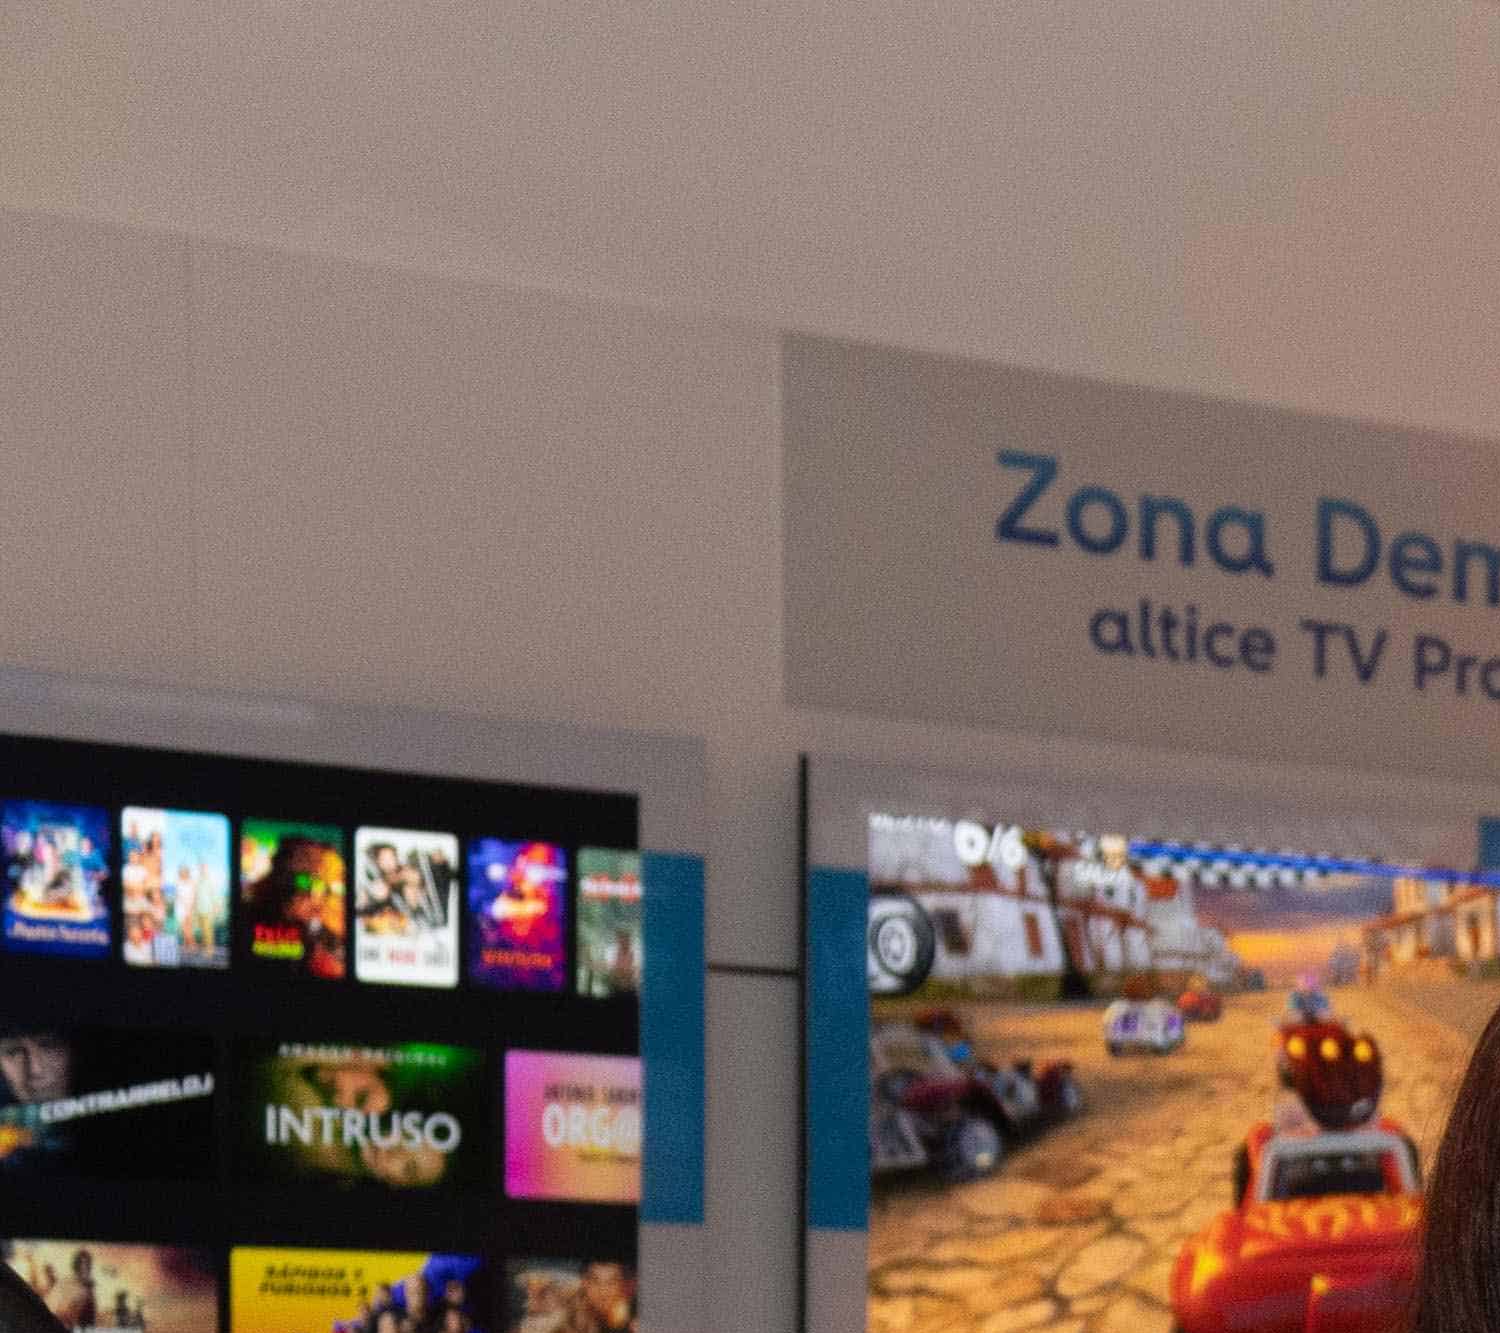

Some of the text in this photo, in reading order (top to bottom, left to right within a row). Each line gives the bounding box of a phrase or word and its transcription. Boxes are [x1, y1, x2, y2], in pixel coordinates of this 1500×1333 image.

[996, 450, 1274, 578] Zona
[1089, 600, 1277, 672] altice
[1299, 619, 1389, 683] TV
[265, 1104, 462, 1153] INTRUSO
